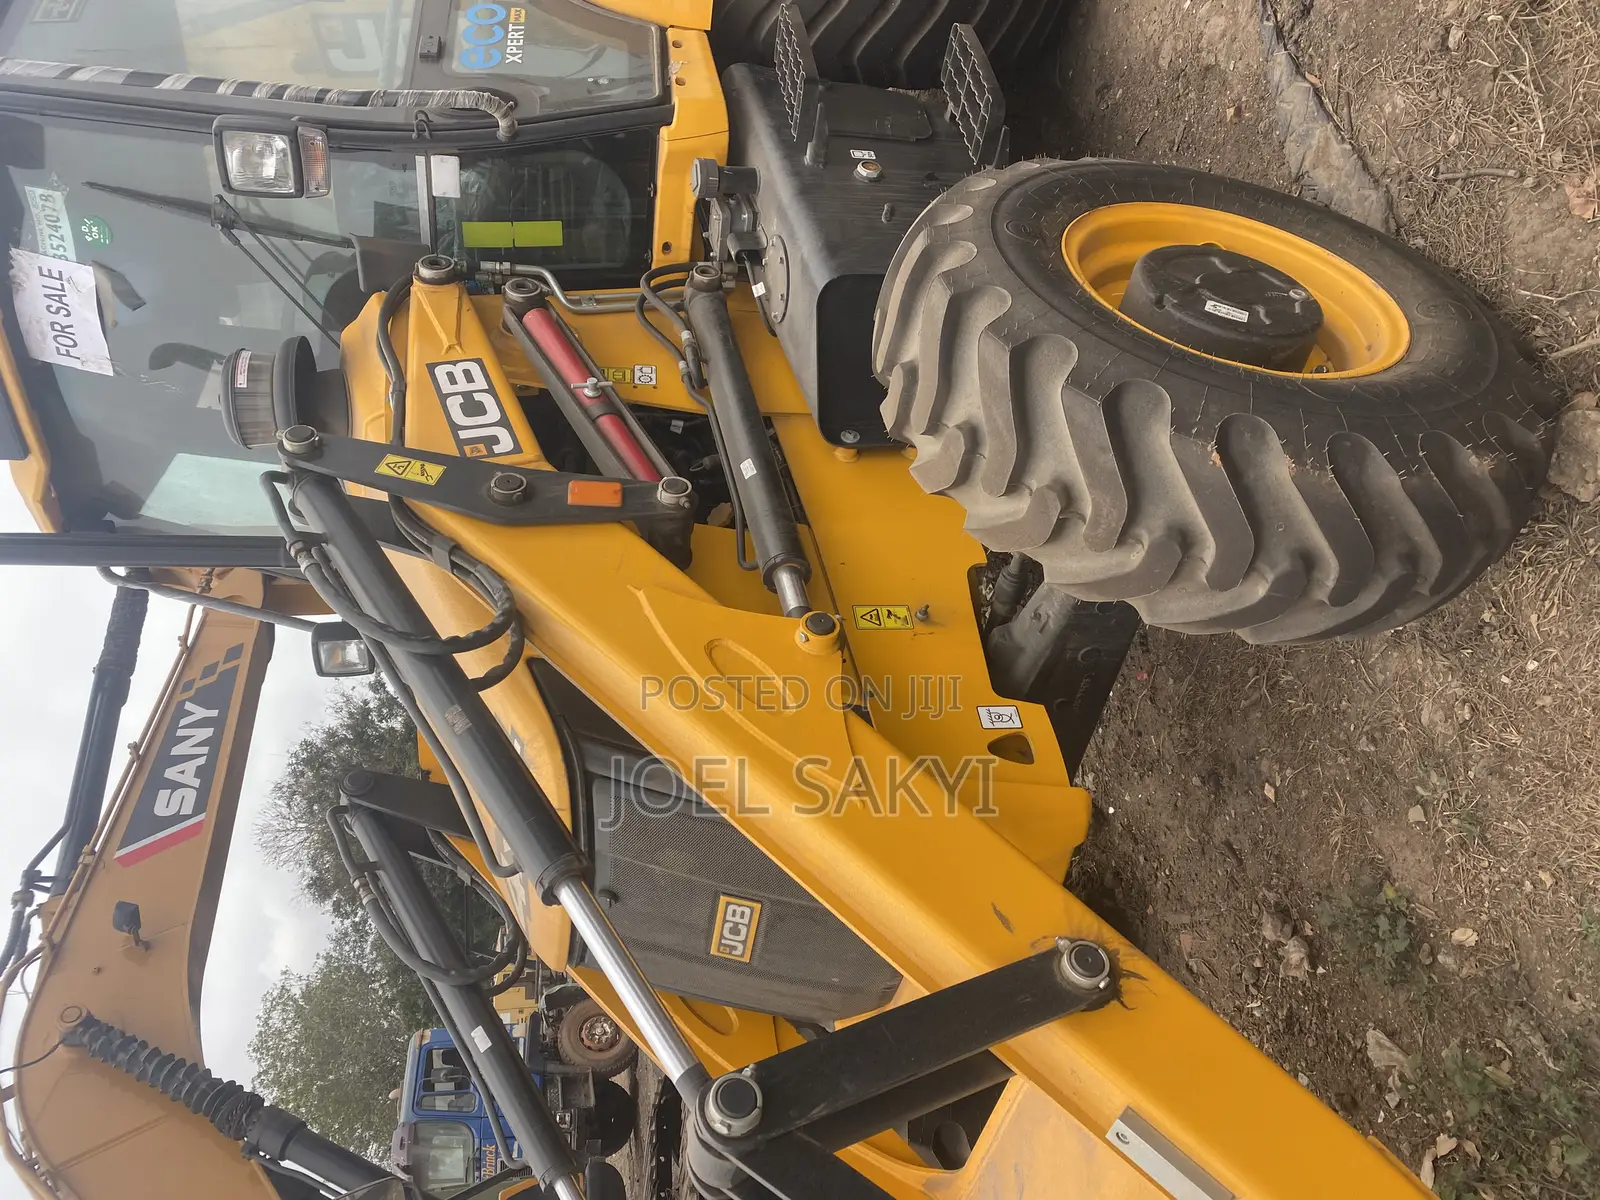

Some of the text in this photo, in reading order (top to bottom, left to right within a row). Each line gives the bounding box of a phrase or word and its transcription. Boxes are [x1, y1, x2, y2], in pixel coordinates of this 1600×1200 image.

[459, 3, 506, 69] eco
[506, 23, 525, 63] XPERT
[90, 225, 99, 239] OK
[38, 265, 81, 360] FOR SALE
[435, 361, 514, 454] JCB
[154, 701, 219, 817] SANY
[721, 904, 750, 955] JCB
